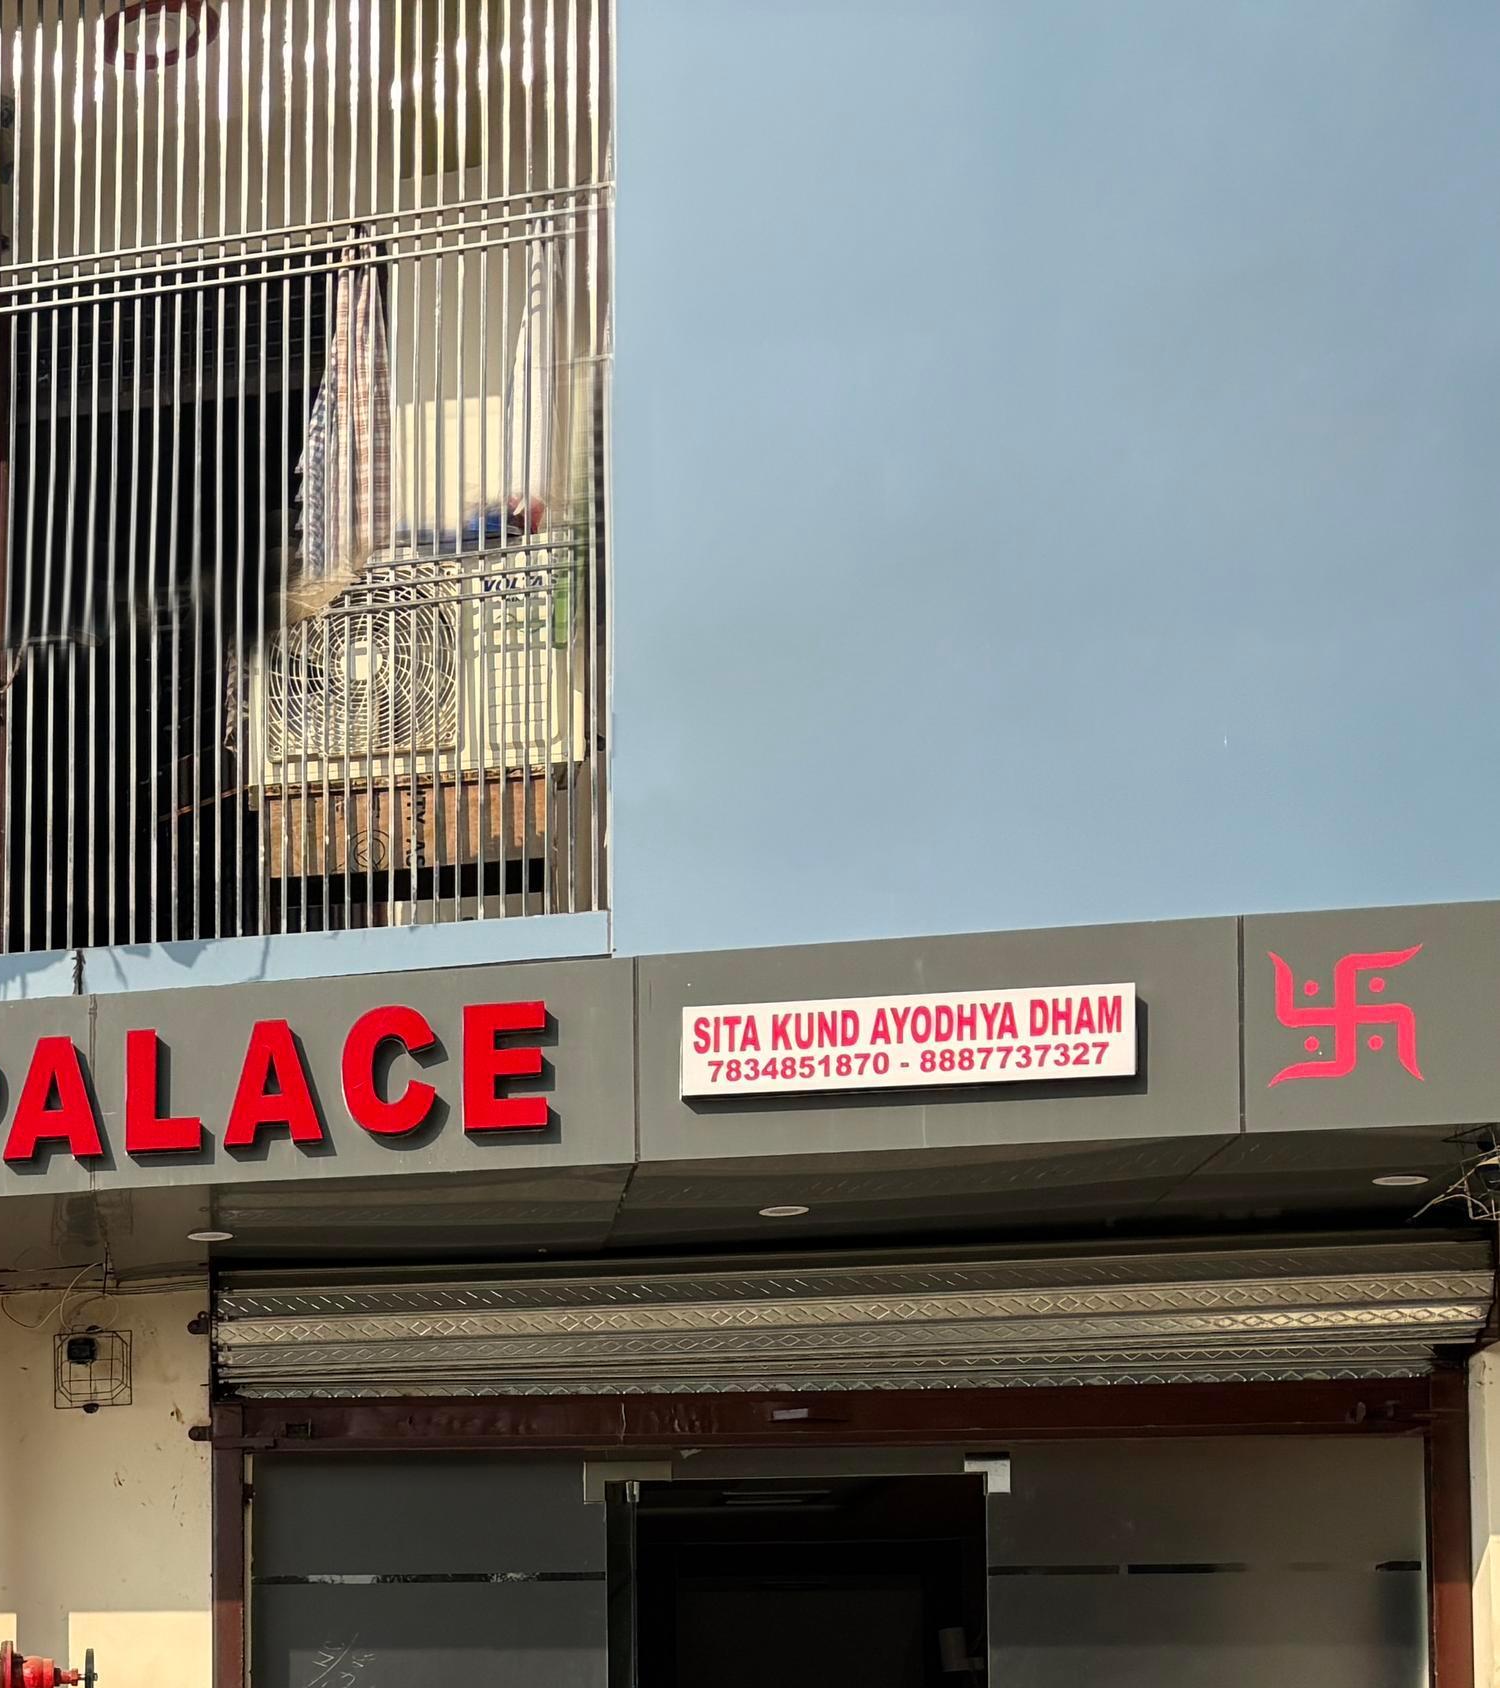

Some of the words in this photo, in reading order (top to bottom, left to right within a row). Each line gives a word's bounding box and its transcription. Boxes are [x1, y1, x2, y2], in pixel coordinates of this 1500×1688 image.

[693, 1015, 761, 1054] SITA
[771, 1010, 860, 1051] KUND
[870, 1002, 1019, 1045] AYODHYA
[1029, 995, 1123, 1037] DHAM
[707, 1051, 890, 1083] 7834851870
[919, 1041, 1110, 1074] 8887737327
